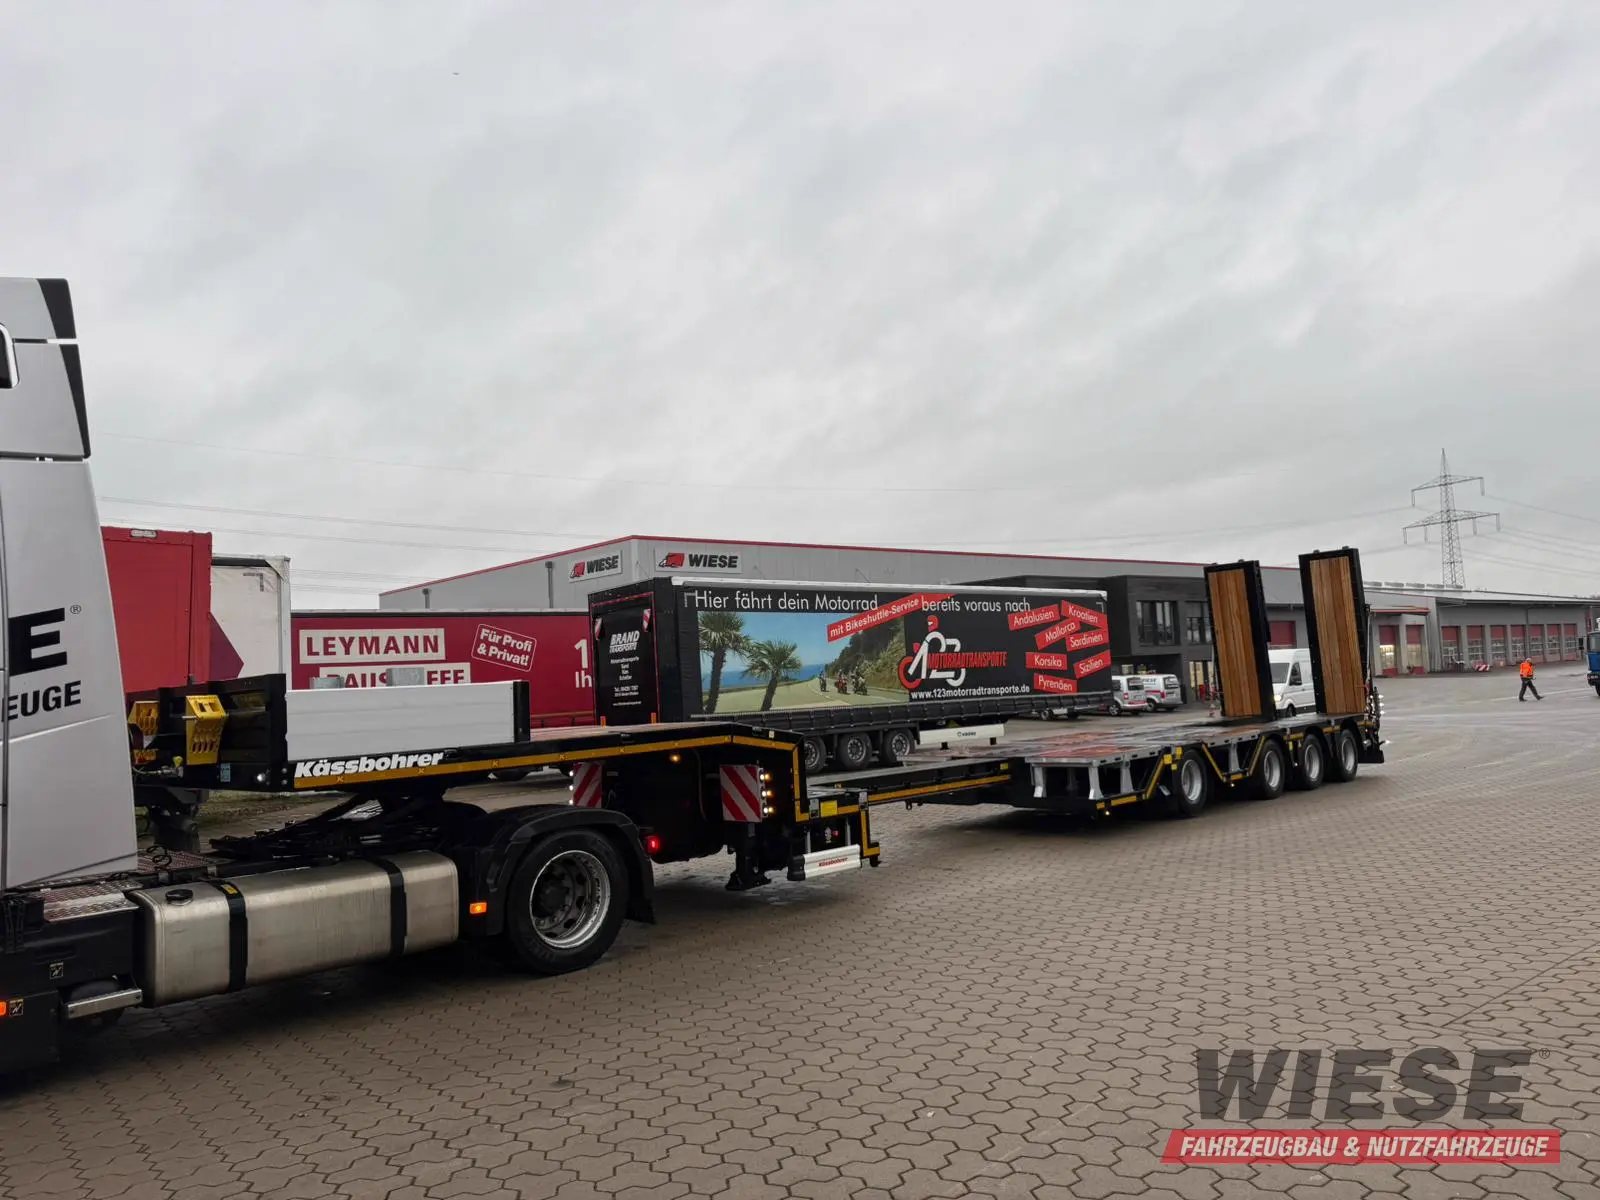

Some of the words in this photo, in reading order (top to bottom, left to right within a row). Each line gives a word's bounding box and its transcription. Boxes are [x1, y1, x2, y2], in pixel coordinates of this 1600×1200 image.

[587, 555, 619, 574] WIESE
[688, 553, 738, 569] WIESE
[695, 590, 729, 609] Hier
[735, 591, 773, 610] fährt
[778, 592, 813, 610] dein
[815, 593, 879, 611] Motorrad
[921, 595, 961, 612] bereits
[964, 599, 1002, 612] voraus
[1005, 597, 1031, 612] nach
[830, 625, 844, 637] mit
[845, 598, 919, 632] Bikeshuttle-Service
[1013, 608, 1055, 628] Andalusien
[1068, 605, 1098, 624] Kroatien
[480, 628, 502, 643] Für
[502, 634, 533, 652] Profi
[610, 630, 640, 646] BRAND
[1045, 621, 1076, 643] Mallorca
[1070, 632, 1103, 648] Sardinien
[306, 634, 440, 657] LEYMANN
[477, 643, 487, 655] &
[488, 645, 530, 666] Privat!
[1034, 654, 1062, 667] Korsika
[1079, 657, 1104, 674] Sizilien
[911, 684, 1031, 699] www.123motorradtransporte.de
[1038, 675, 1073, 692] Pyrenäen
[294, 751, 444, 778] Kässbohrer
